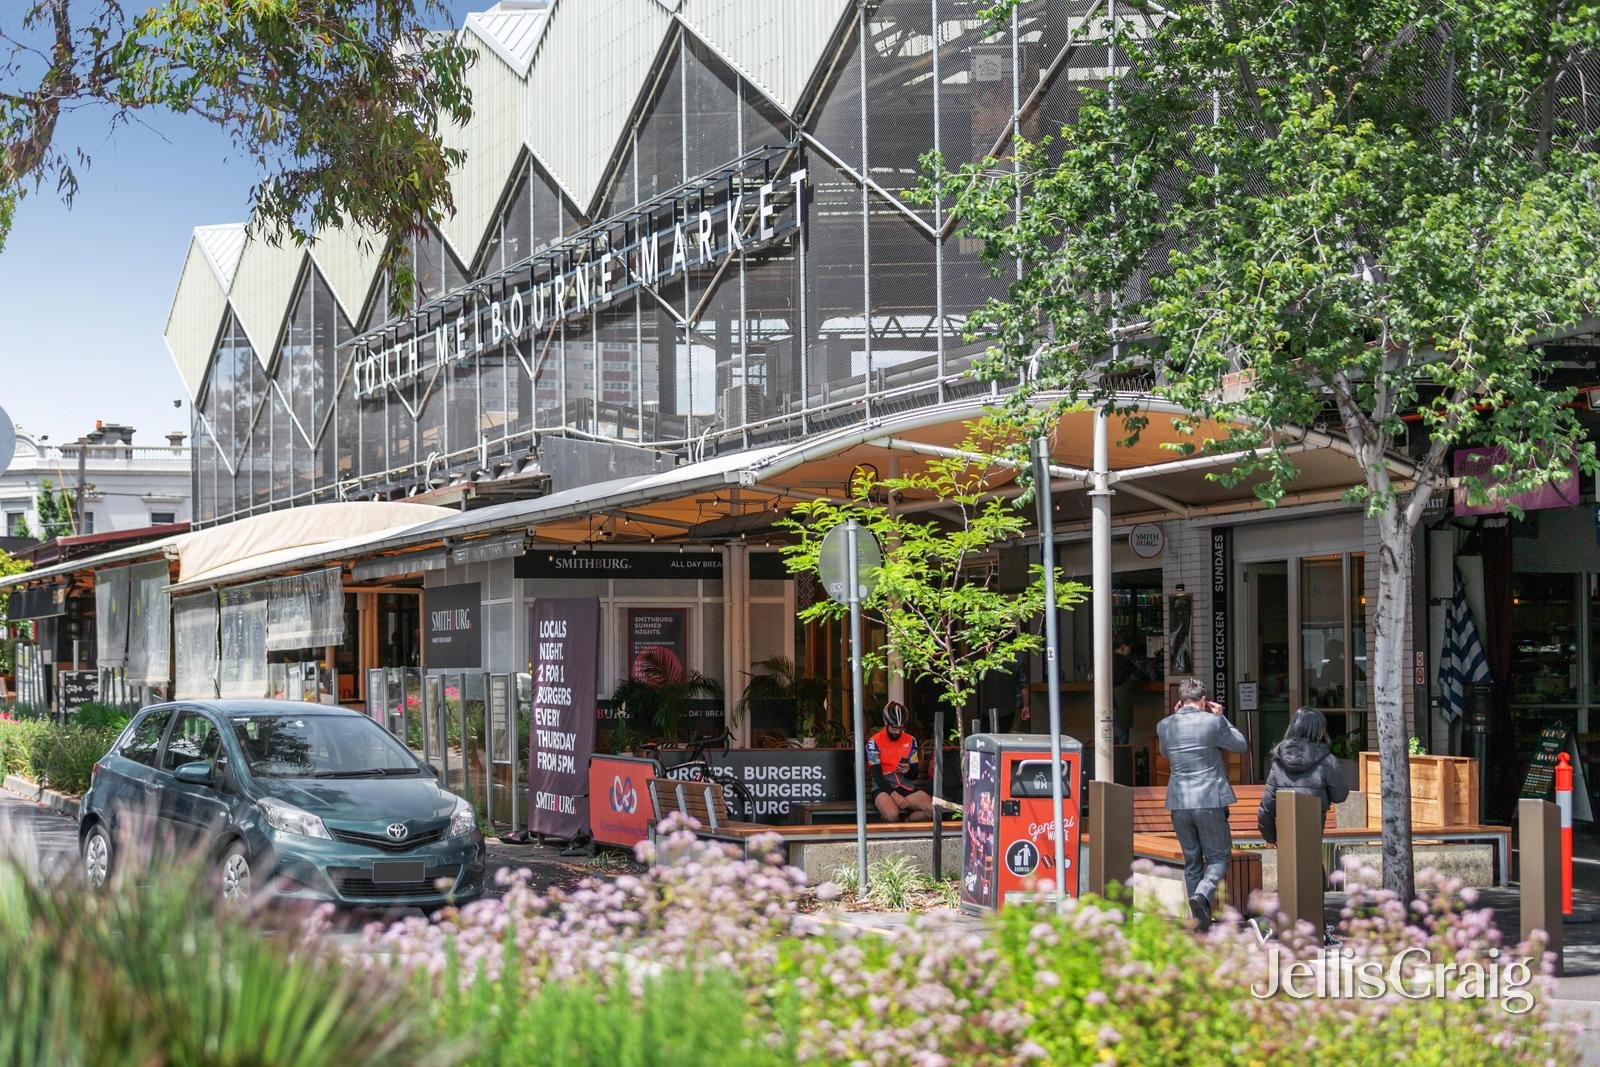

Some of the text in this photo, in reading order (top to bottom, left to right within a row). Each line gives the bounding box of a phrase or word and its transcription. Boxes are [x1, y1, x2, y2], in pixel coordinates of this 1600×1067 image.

[354, 168, 807, 400] SOUTH MELBOURNE MARKET
[539, 620, 567, 638] LOCALS
[1214, 534, 1226, 709] RIED CHICKEN SUNDAES
[539, 642, 564, 660] NIGHT.
[537, 664, 565, 682] 2 FOR 1
[536, 686, 572, 706] BURGERS
[535, 707, 561, 727] EVERY
[689, 710, 703, 718] DAY
[536, 729, 576, 751] THURSDAY
[537, 751, 576, 774] FROM 5PM.
[744, 766, 826, 780] BURGERS.
[1028, 815, 1075, 842] Geneal
